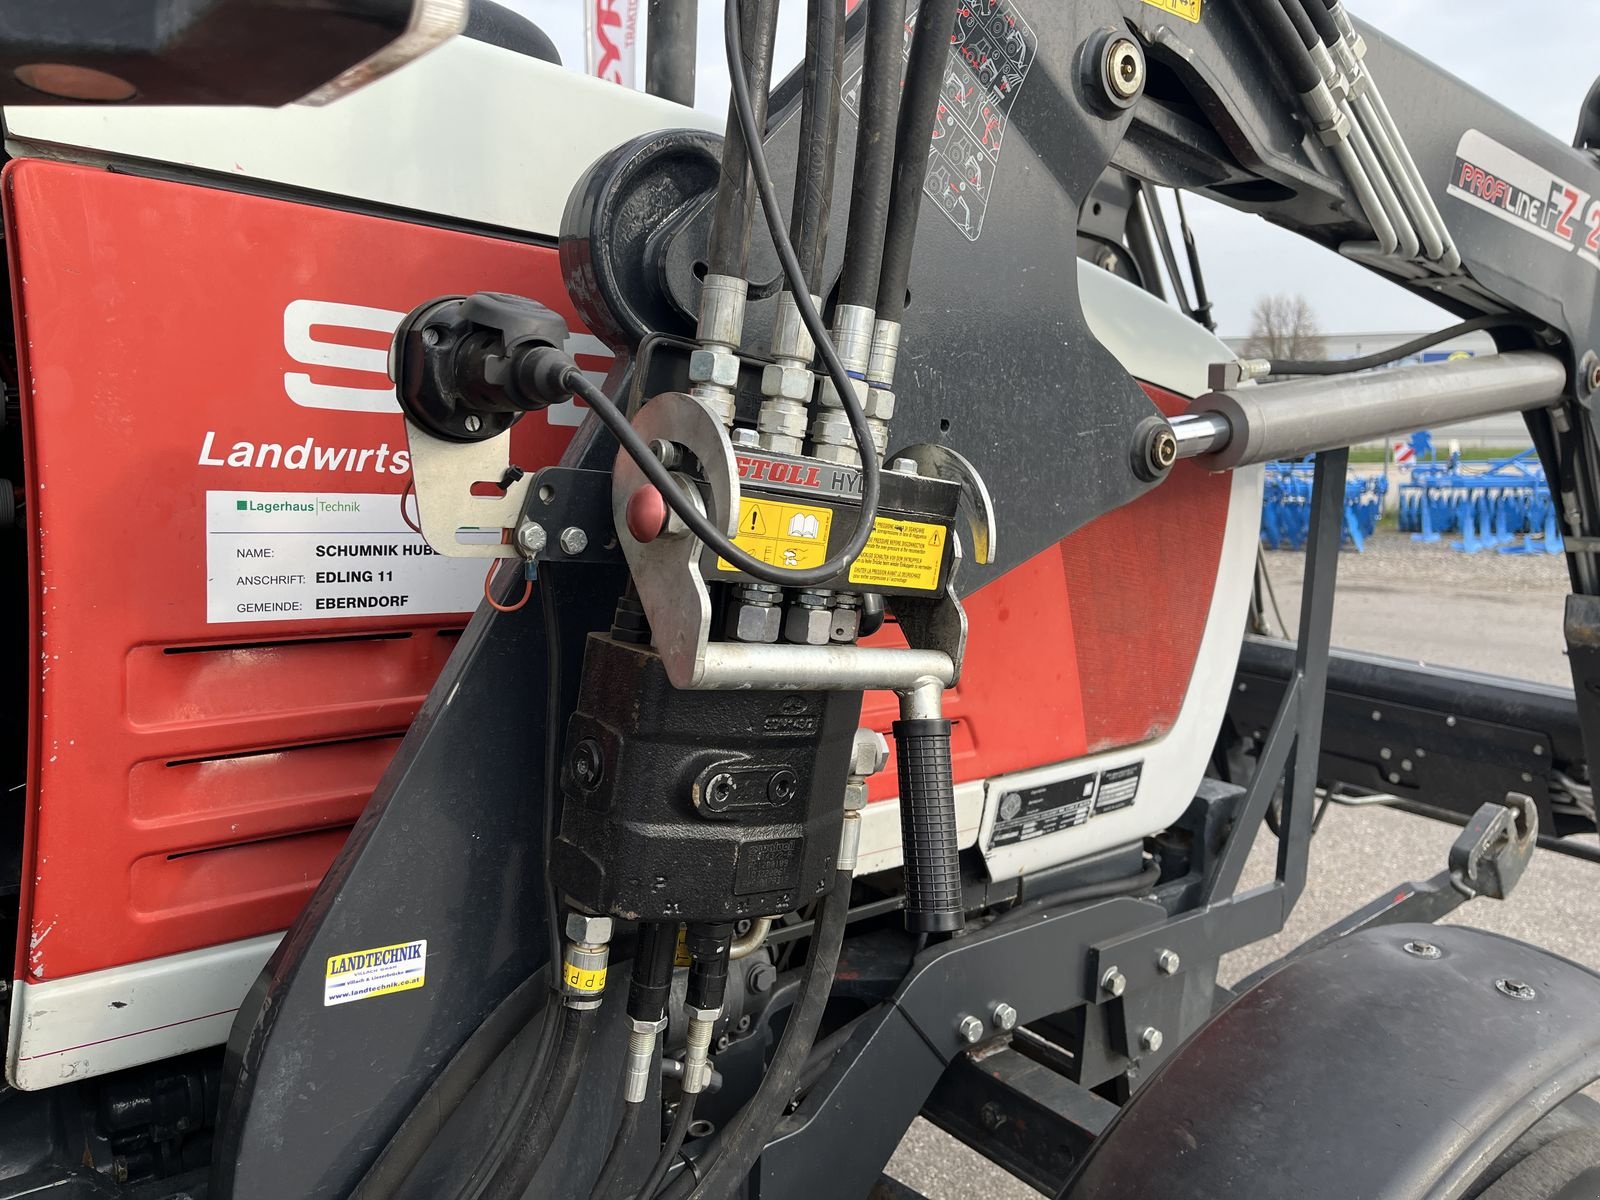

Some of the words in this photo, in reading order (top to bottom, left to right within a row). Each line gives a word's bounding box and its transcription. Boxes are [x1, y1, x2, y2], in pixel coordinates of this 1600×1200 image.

[249, 500, 315, 513] Lagerhaus
[318, 501, 360, 513] Technik
[236, 548, 275, 558] NAME:
[315, 545, 399, 557] SCHUMNIK
[236, 575, 306, 586] ANSCHRIFT:
[315, 571, 373, 583] EDLING
[377, 570, 393, 582] 11
[236, 601, 303, 613] GEMEINDE:
[315, 595, 409, 610] EBERNDORF
[330, 944, 422, 975] LANDTECHNIK
[329, 977, 420, 1001] www.landtechnik.co.at
